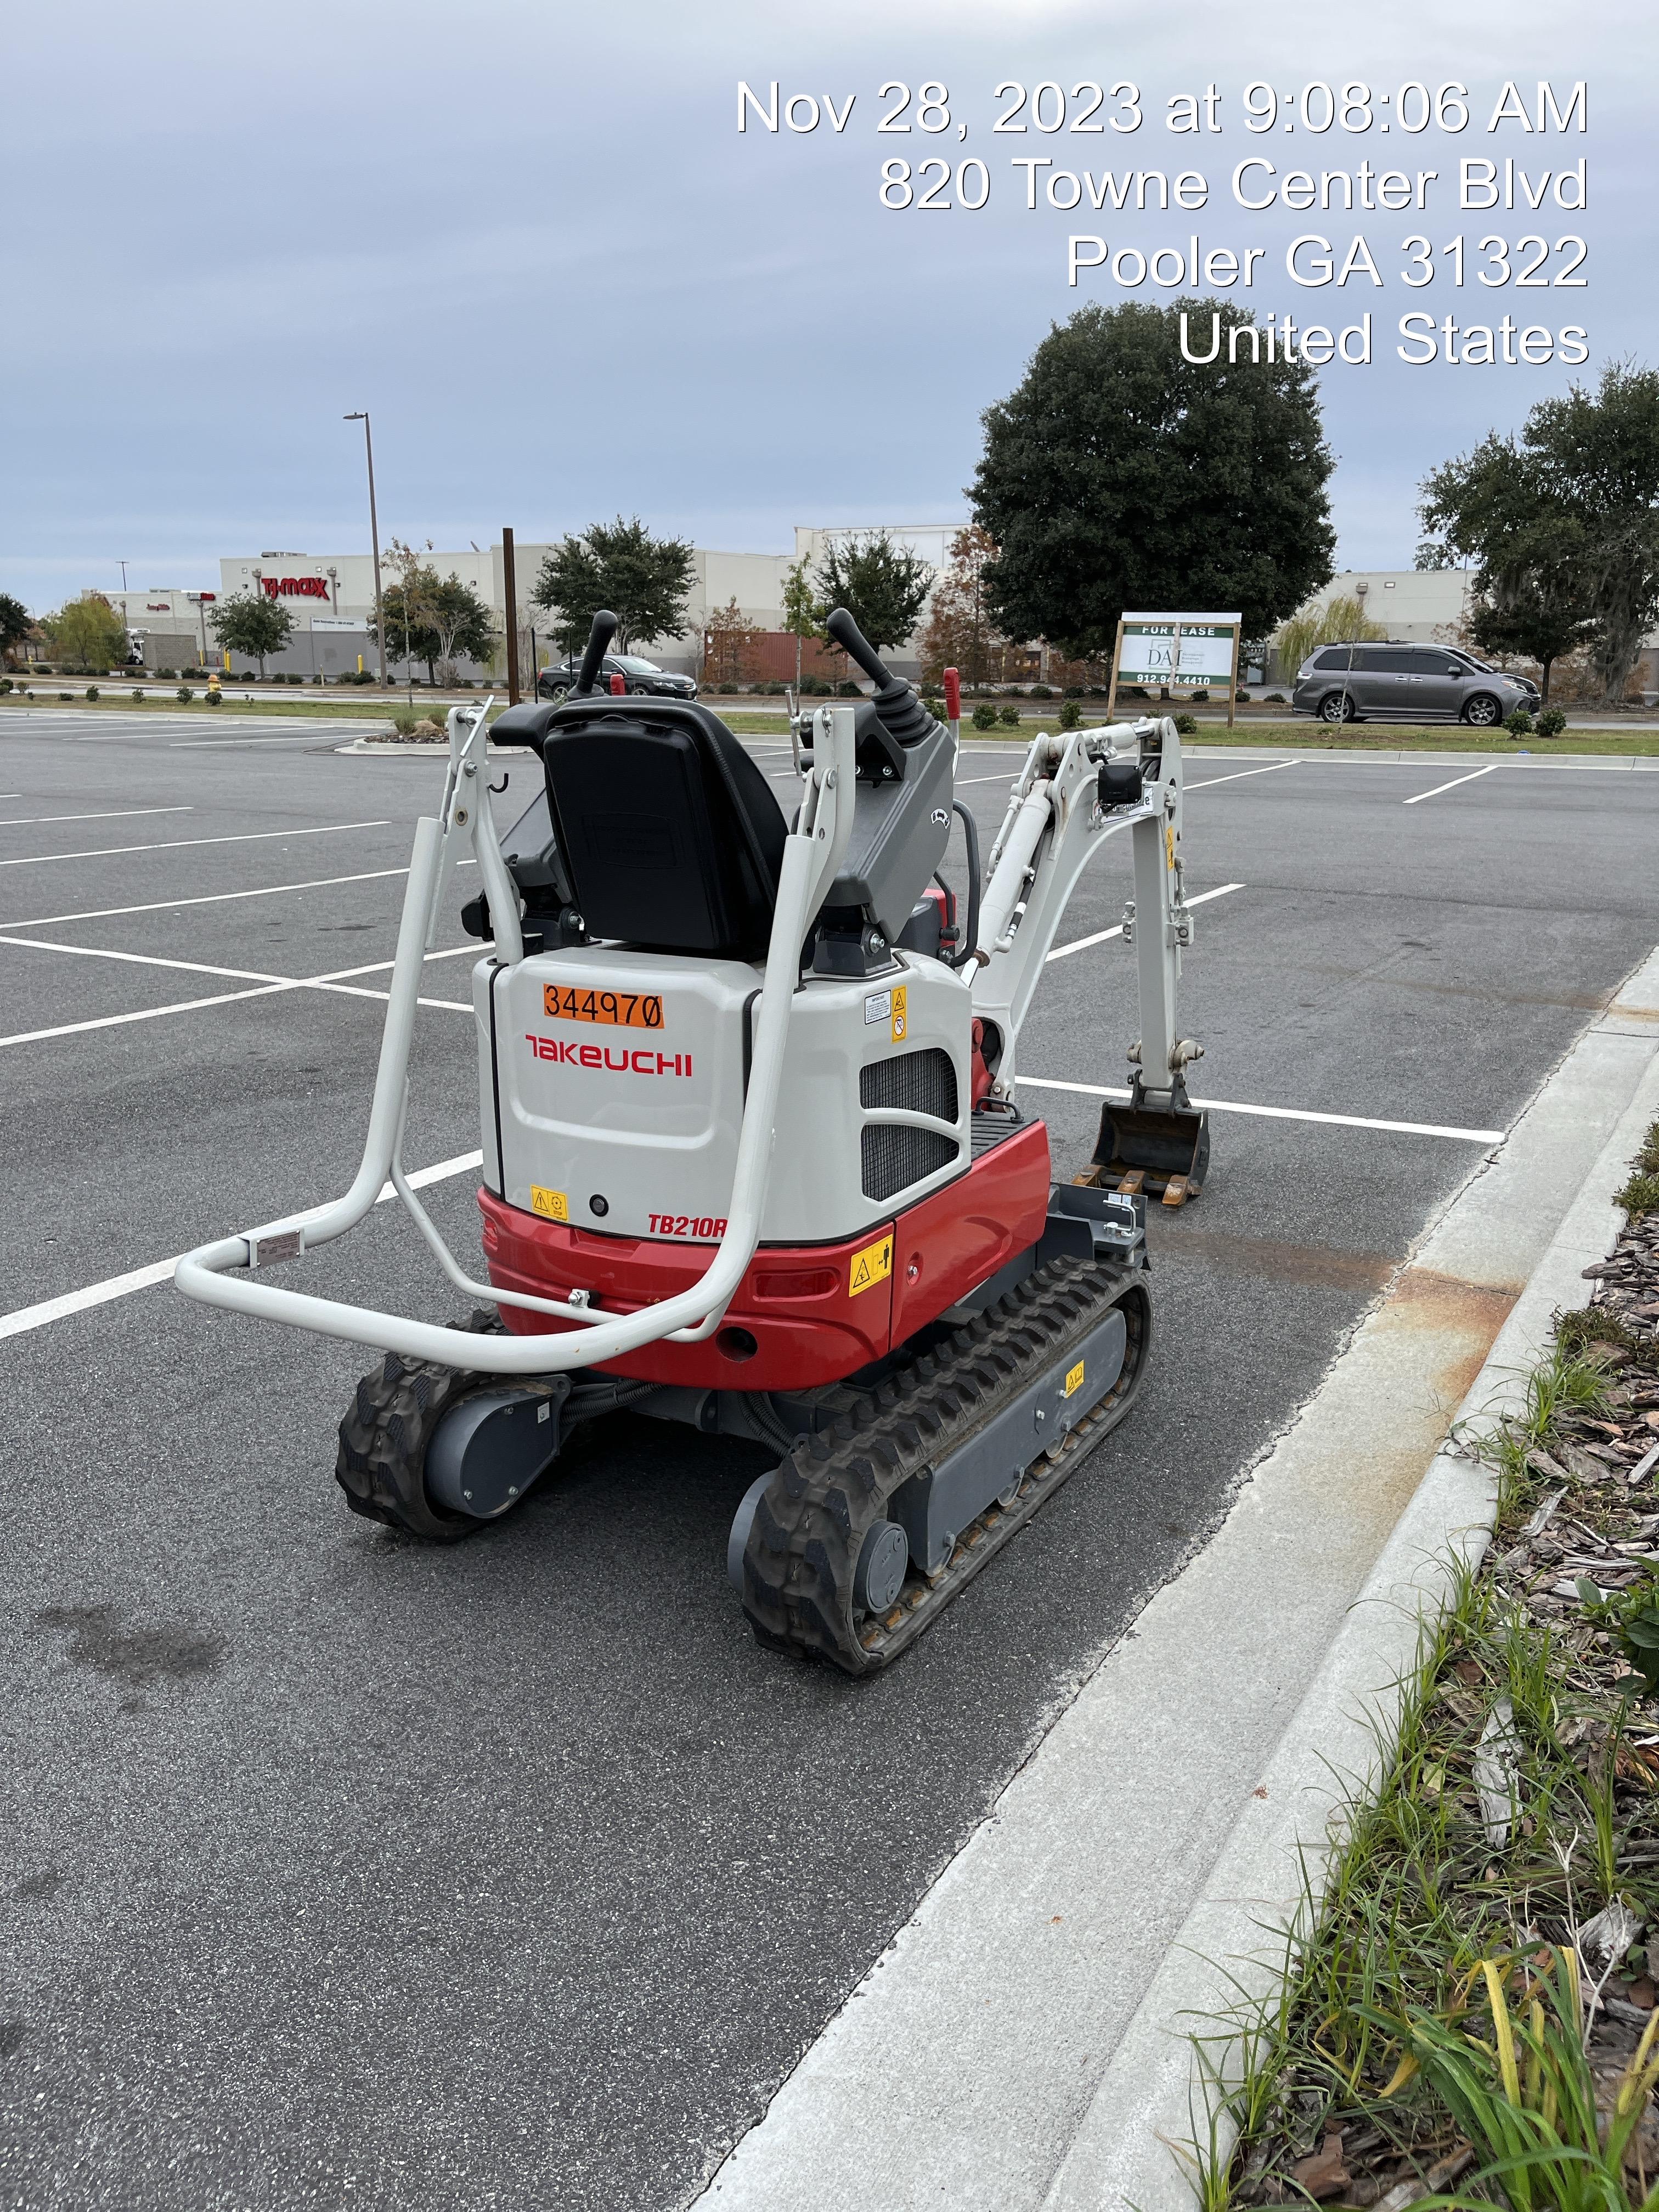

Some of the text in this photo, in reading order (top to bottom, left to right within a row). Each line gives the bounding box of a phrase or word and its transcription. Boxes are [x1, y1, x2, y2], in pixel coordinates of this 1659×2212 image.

[1142, 626, 1168, 635] FOR
[1147, 649, 1183, 666] DAI
[546, 985, 661, 1027] 344970
[648, 1214, 728, 1238] TB210R
